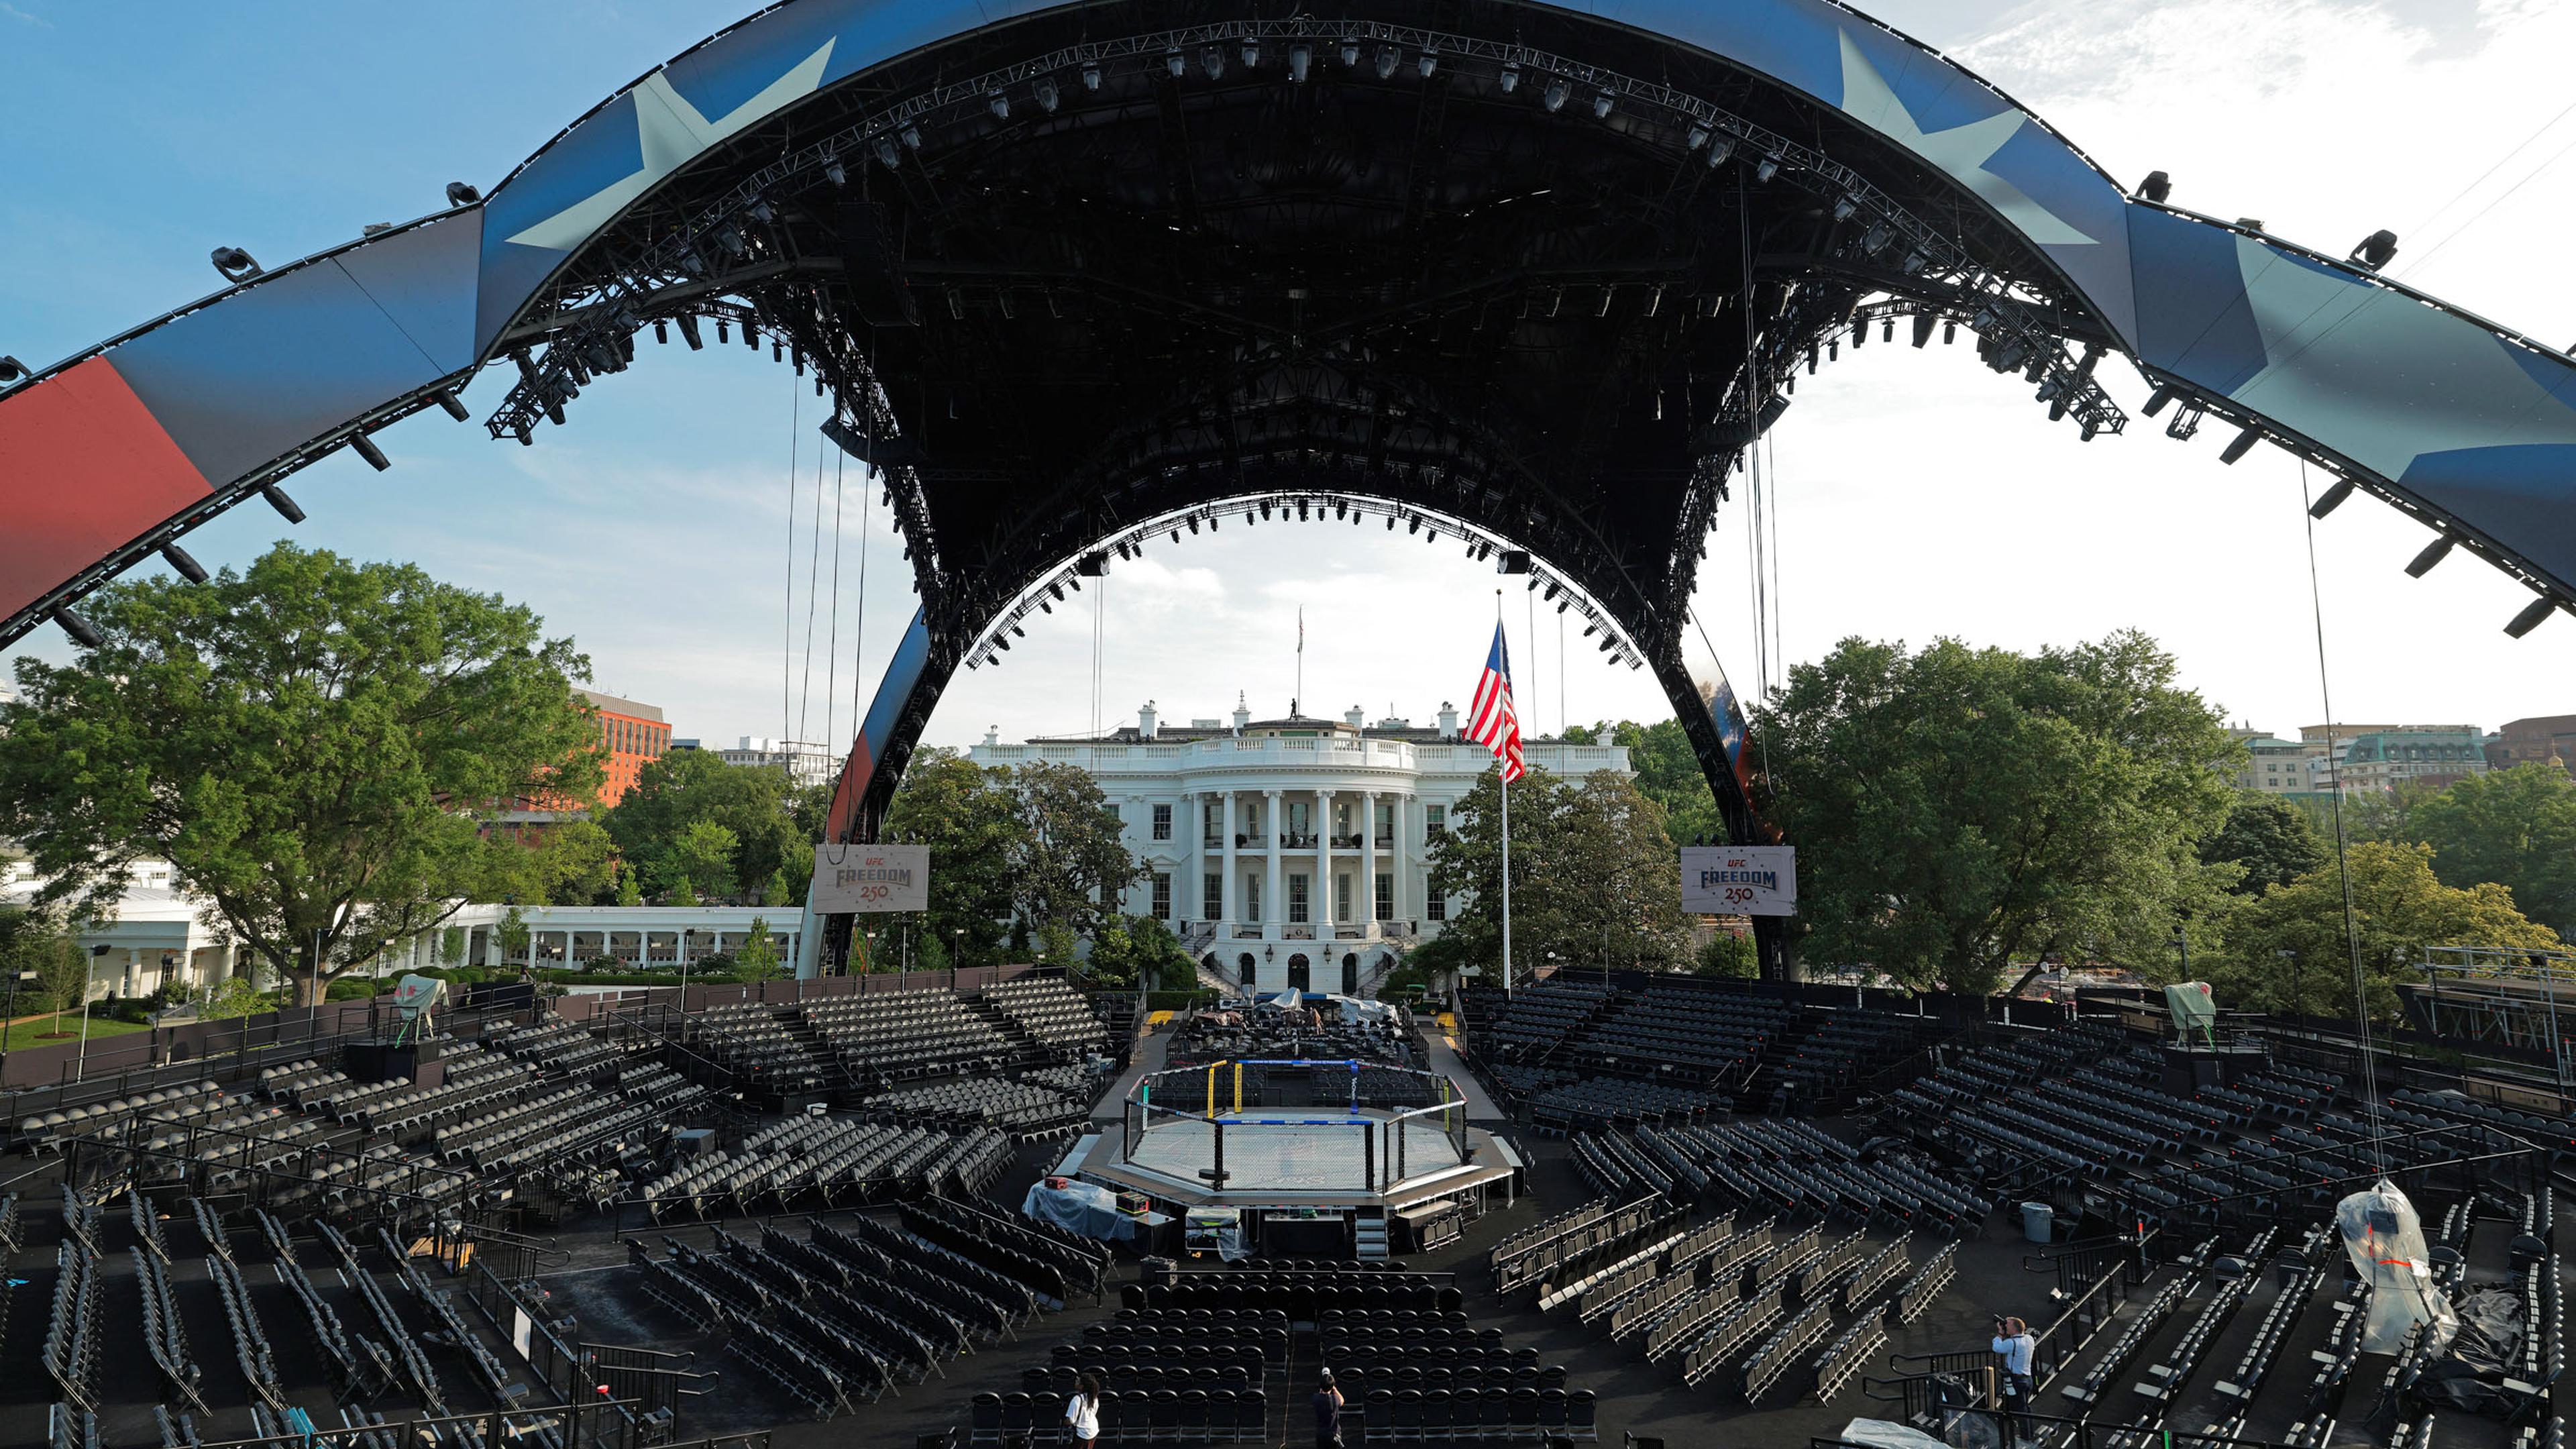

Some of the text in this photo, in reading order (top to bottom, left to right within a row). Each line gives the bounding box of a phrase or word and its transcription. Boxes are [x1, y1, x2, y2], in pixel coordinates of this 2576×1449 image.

[865, 857, 883, 866] UFC
[1727, 859, 1747, 867] UFC
[837, 869, 911, 889] FREEDOM
[1701, 871, 1776, 891] FREEDOM
[860, 885, 888, 902] 250
[1725, 888, 1753, 904] 250
